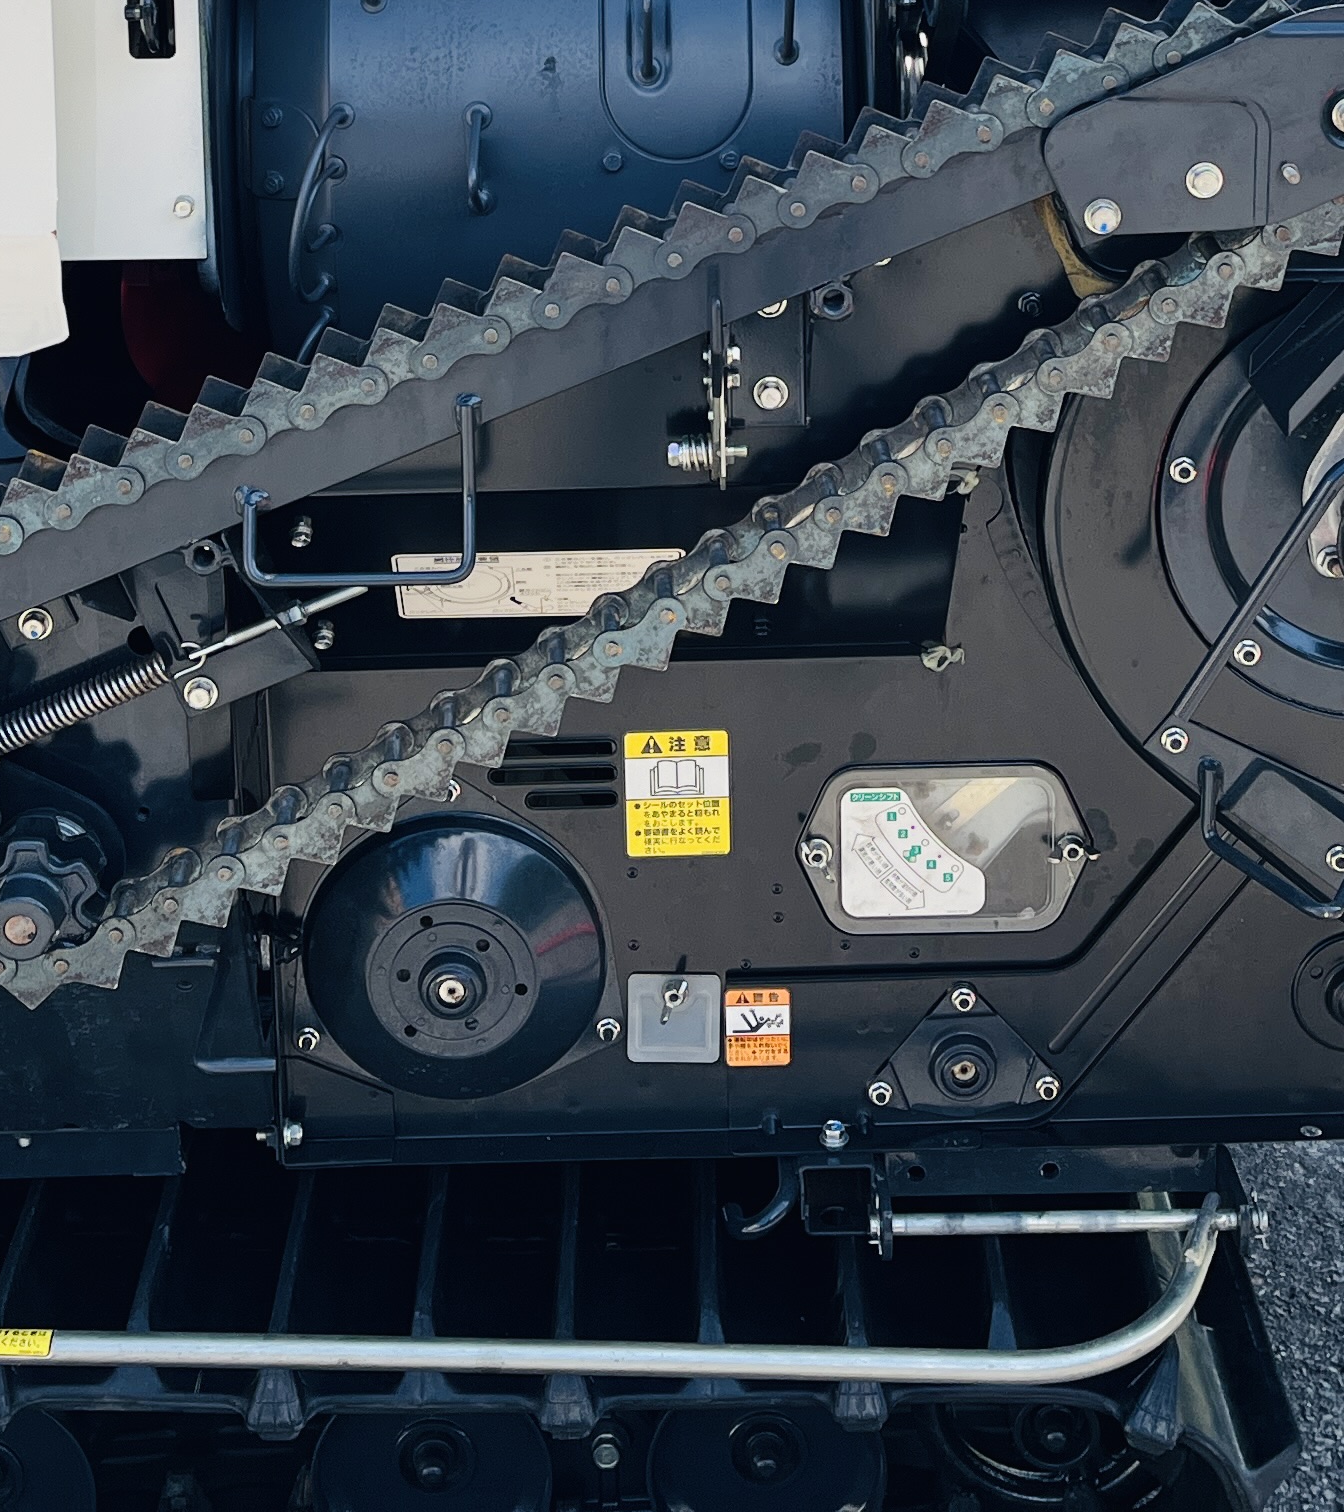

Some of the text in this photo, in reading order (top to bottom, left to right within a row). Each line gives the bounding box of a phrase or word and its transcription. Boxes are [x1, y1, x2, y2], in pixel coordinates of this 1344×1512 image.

[669, 735, 710, 751] 注意
[851, 792, 900, 801] クリーンシフト
